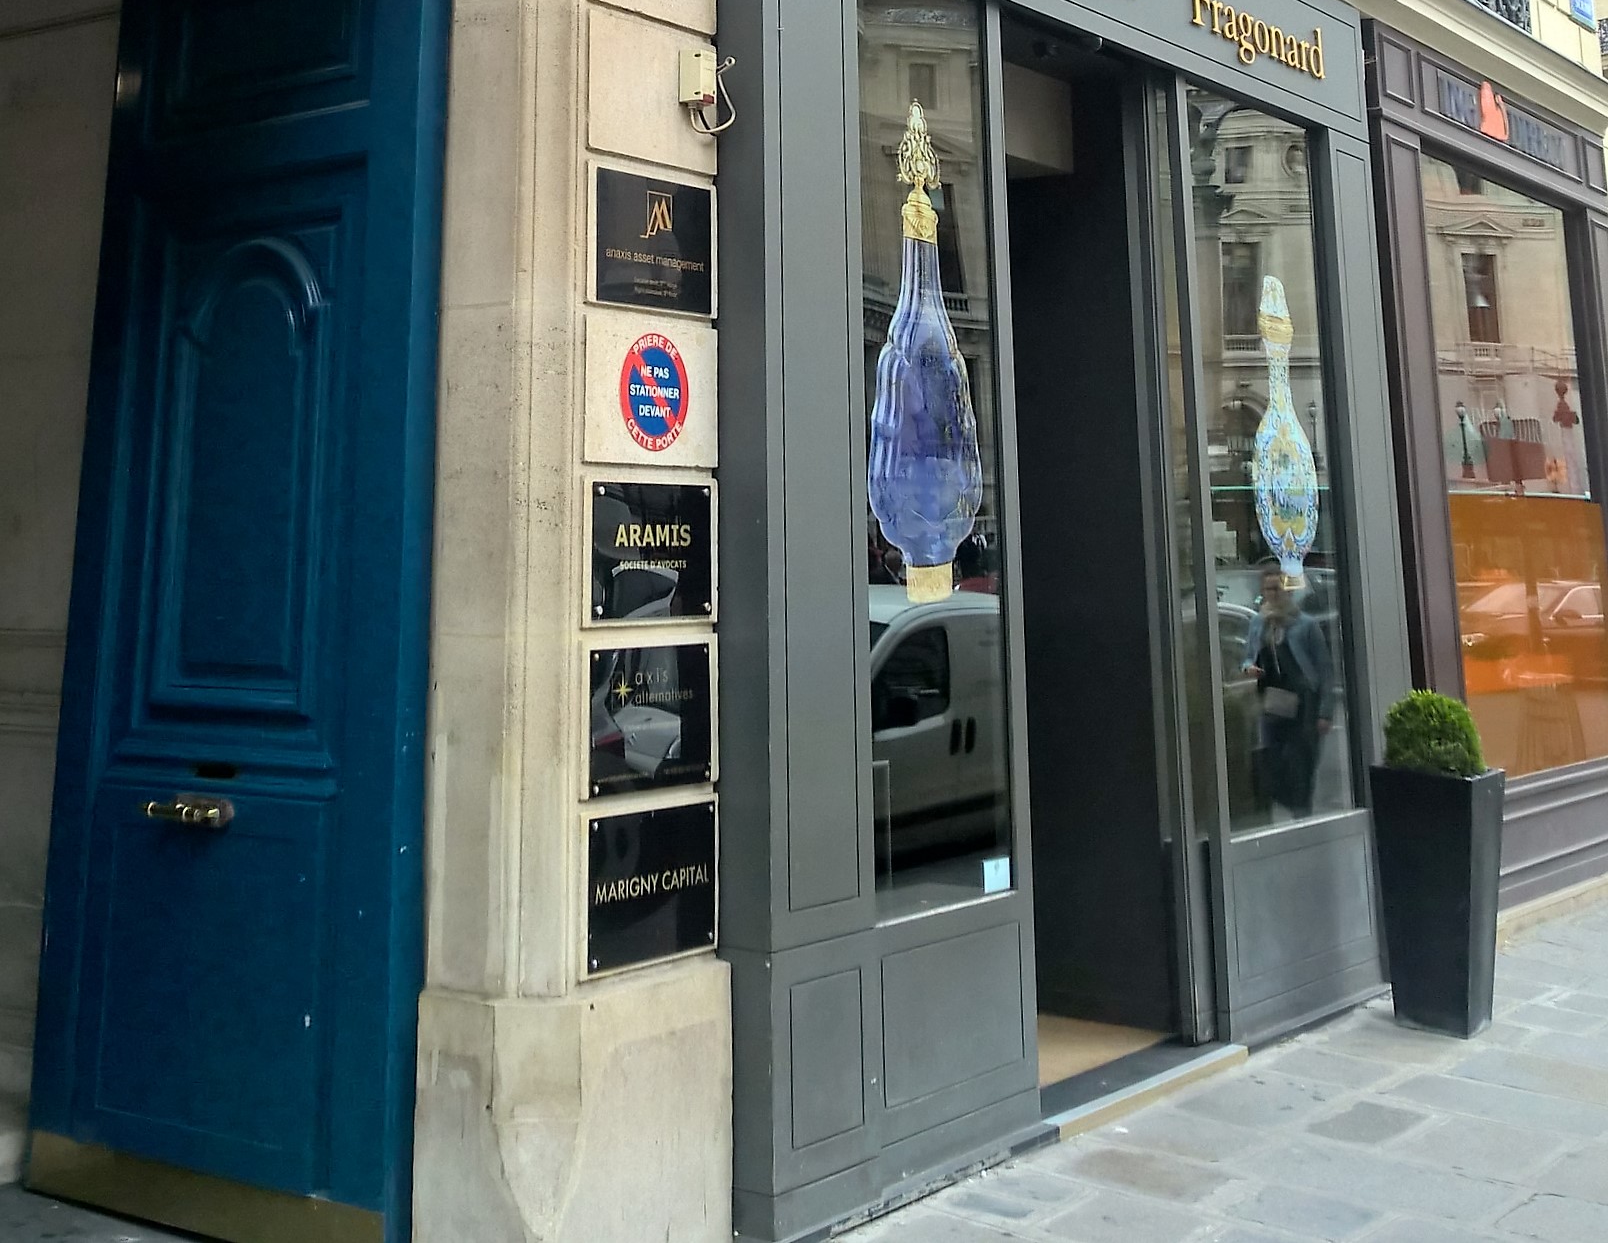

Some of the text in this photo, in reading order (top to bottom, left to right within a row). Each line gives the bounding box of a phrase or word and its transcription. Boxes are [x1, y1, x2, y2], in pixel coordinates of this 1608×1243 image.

[606, 247, 705, 272] anaxis asset management
[665, 342, 678, 360] DE
[641, 365, 670, 379] NE PAS
[630, 384, 680, 399] STATIONNER
[639, 405, 671, 418] DEVANT
[627, 419, 682, 450] CETTE PORTE
[615, 524, 692, 547] ARAMIS
[650, 560, 687, 570] D'AVOCATS
[635, 687, 693, 705] alternatives
[595, 862, 709, 905] MARIGNY CAPITAL
